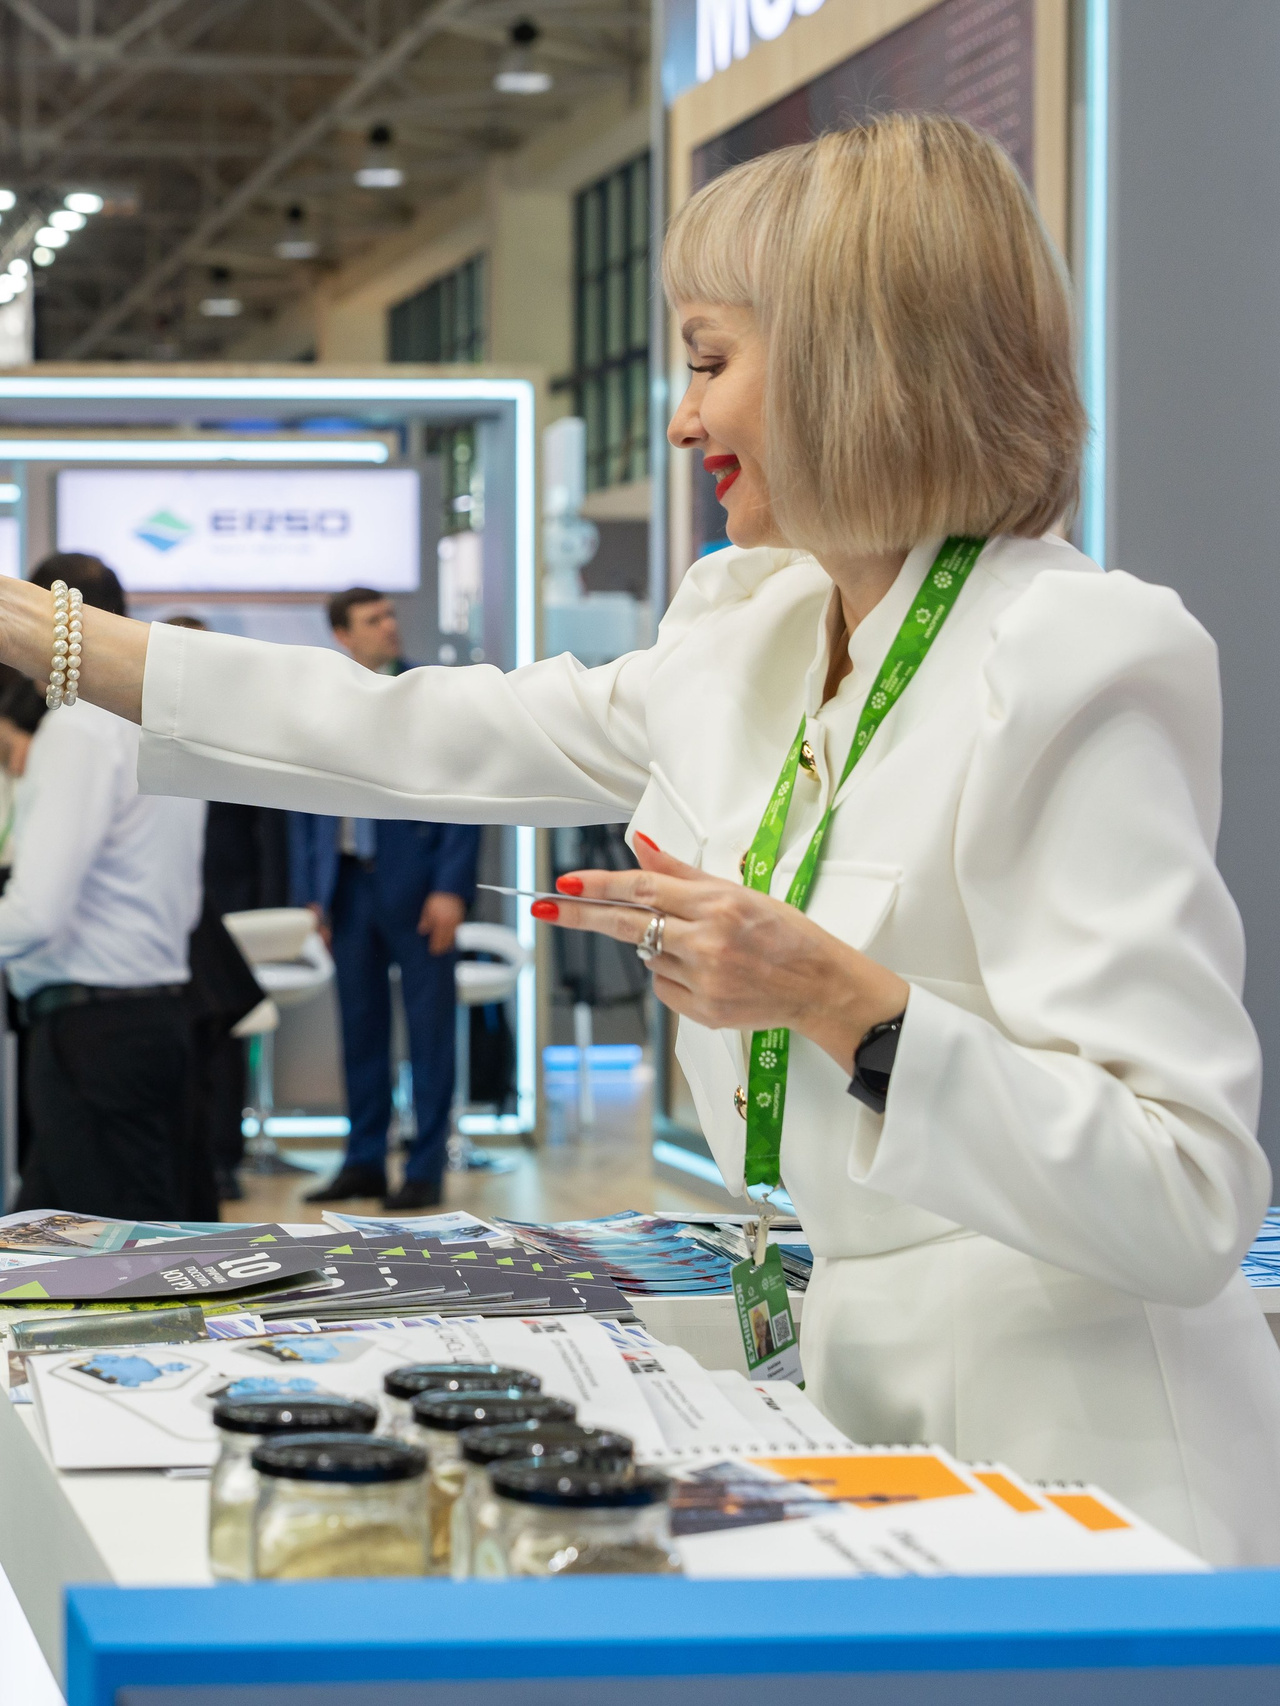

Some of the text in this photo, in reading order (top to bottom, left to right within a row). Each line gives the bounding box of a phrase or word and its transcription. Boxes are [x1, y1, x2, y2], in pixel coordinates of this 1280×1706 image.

[209, 509, 351, 538] ERSO
[160, 1268, 198, 1291] ЮГРУ
[217, 1252, 282, 1279] 10
[735, 1282, 756, 1365] EXHIBITOR
